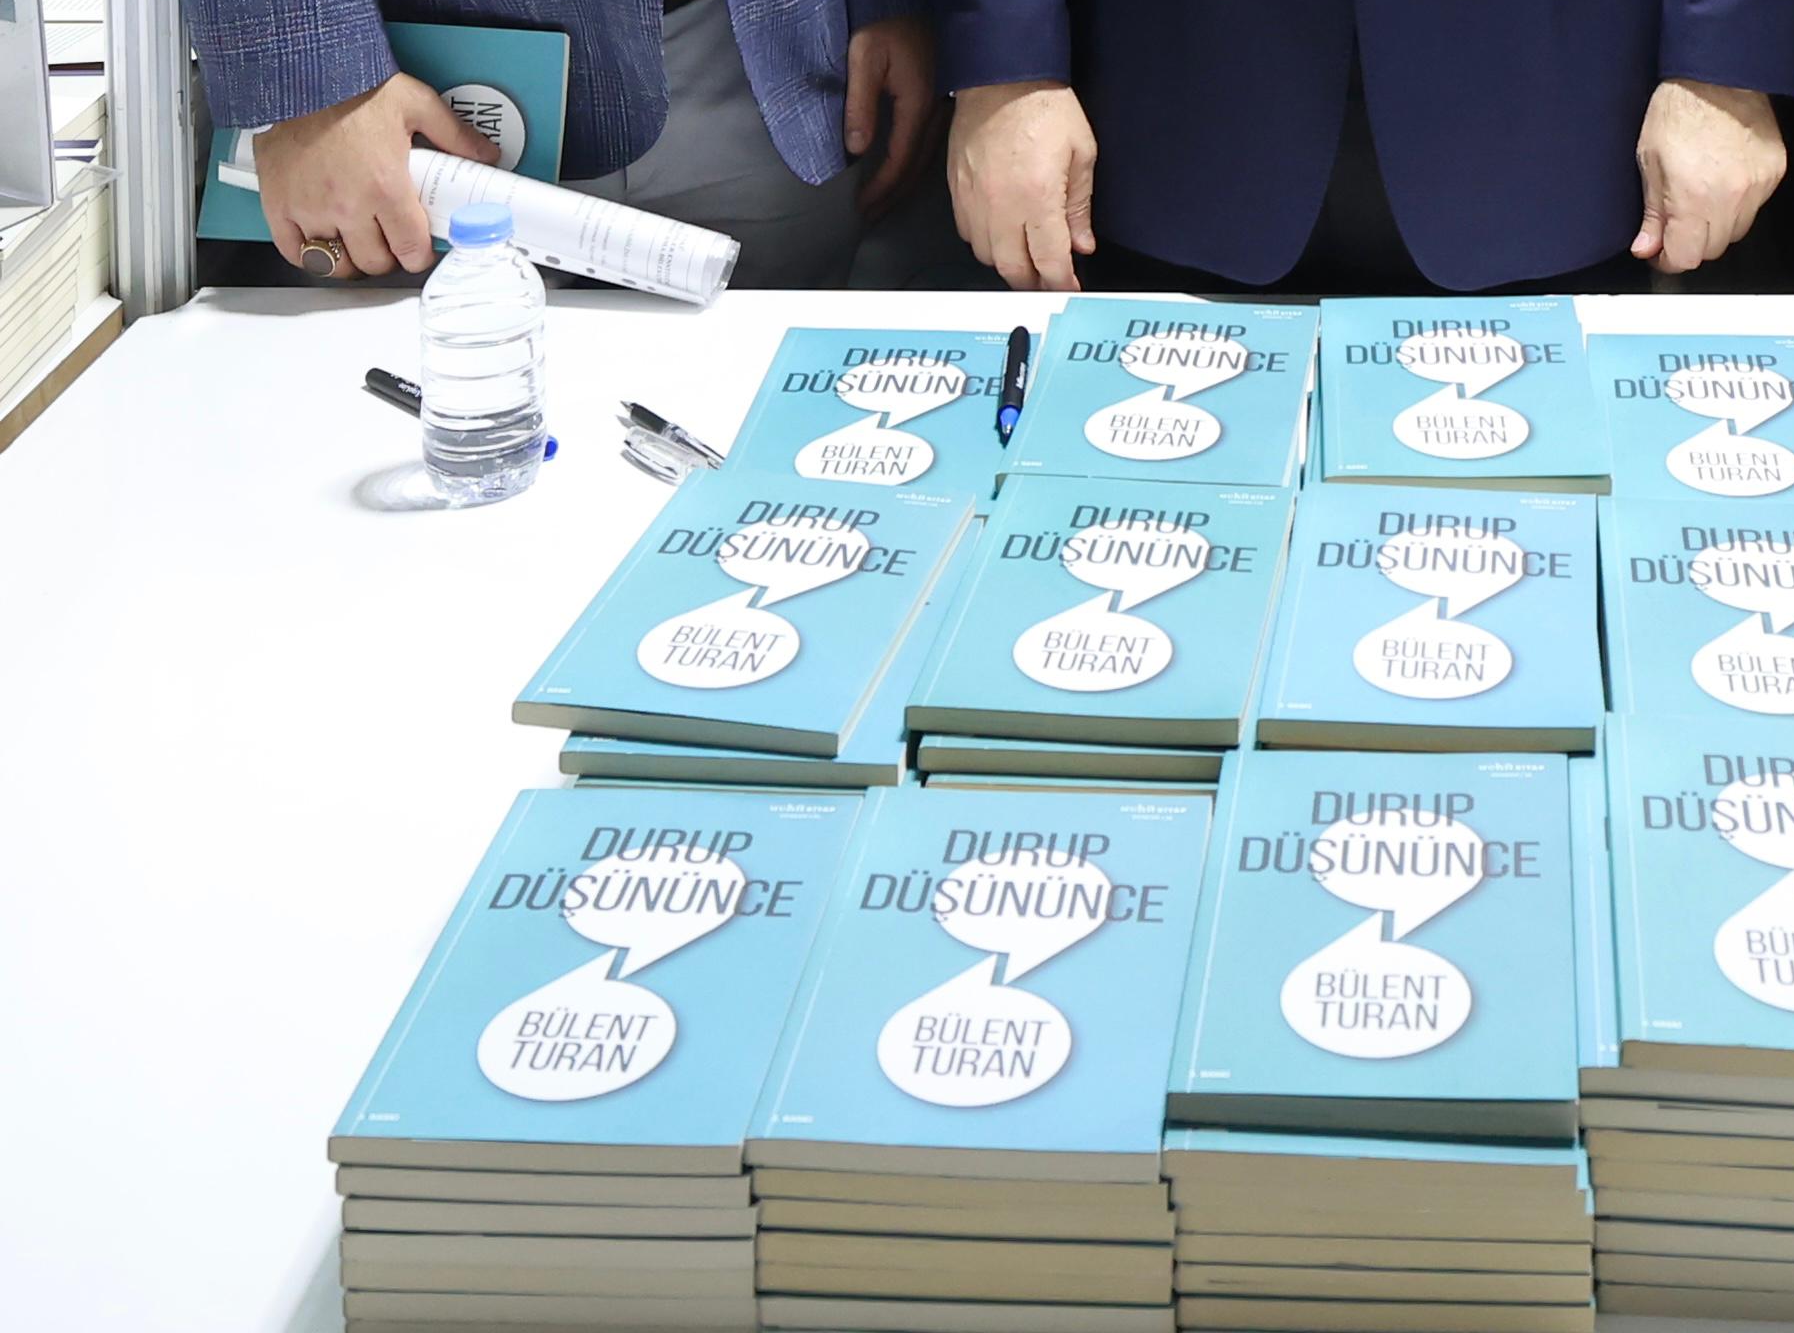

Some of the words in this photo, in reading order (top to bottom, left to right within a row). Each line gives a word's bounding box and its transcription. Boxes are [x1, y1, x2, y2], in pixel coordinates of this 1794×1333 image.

[1126, 318, 1248, 343] DURUP
[1391, 318, 1512, 339] DURUP
[842, 346, 967, 368] DURUP
[1066, 340, 1289, 373] DÜŞÜNÜNCE
[1345, 340, 1566, 369] DÜŞÜNÜNCE
[1658, 352, 1778, 374] DURUP
[782, 369, 1002, 399] DÜŞÜNÜNCE
[1110, 411, 1206, 434] BÜLENT
[1416, 411, 1508, 430] BÜLENT
[820, 441, 919, 461] BÜLENT
[1108, 429, 1197, 448] TURAN
[1420, 428, 1508, 446] TURAN
[816, 459, 908, 477] TURAN
[1688, 447, 1782, 467] BÜLENT
[1694, 465, 1782, 483] TURAN
[736, 499, 881, 534] DURUP
[1068, 505, 1211, 533] DURUP
[1378, 511, 1517, 540] DURUP
[657, 526, 917, 577] DÜŞÜNÜNCE
[999, 529, 1259, 574] DÜŞÜNÜNCE
[1316, 538, 1574, 580] DÜŞÜNÜNCE
[670, 623, 788, 653] BÜLENT
[1043, 629, 1157, 655] BÜLENT
[1381, 636, 1492, 662] BÜLENT
[661, 644, 770, 673] TURAN
[1040, 650, 1142, 676] TURAN
[1381, 658, 1486, 683] TURAN
[1310, 790, 1475, 828] DURUP
[580, 826, 754, 865] DURUP
[942, 829, 1110, 868] DURUP
[1237, 831, 1542, 883] DÜŞÜNÜNCE
[488, 867, 803, 919] DÜŞÜNÜNCE
[858, 870, 1170, 924] DÜŞÜNÜNCE
[1314, 968, 1448, 1000] BÜLENT
[515, 1006, 659, 1042] BÜLENT
[912, 1012, 1051, 1047] BÜLENT
[1314, 1000, 1439, 1031] TURAN
[509, 1040, 637, 1073] TURAN
[911, 1045, 1037, 1078] TURAN
